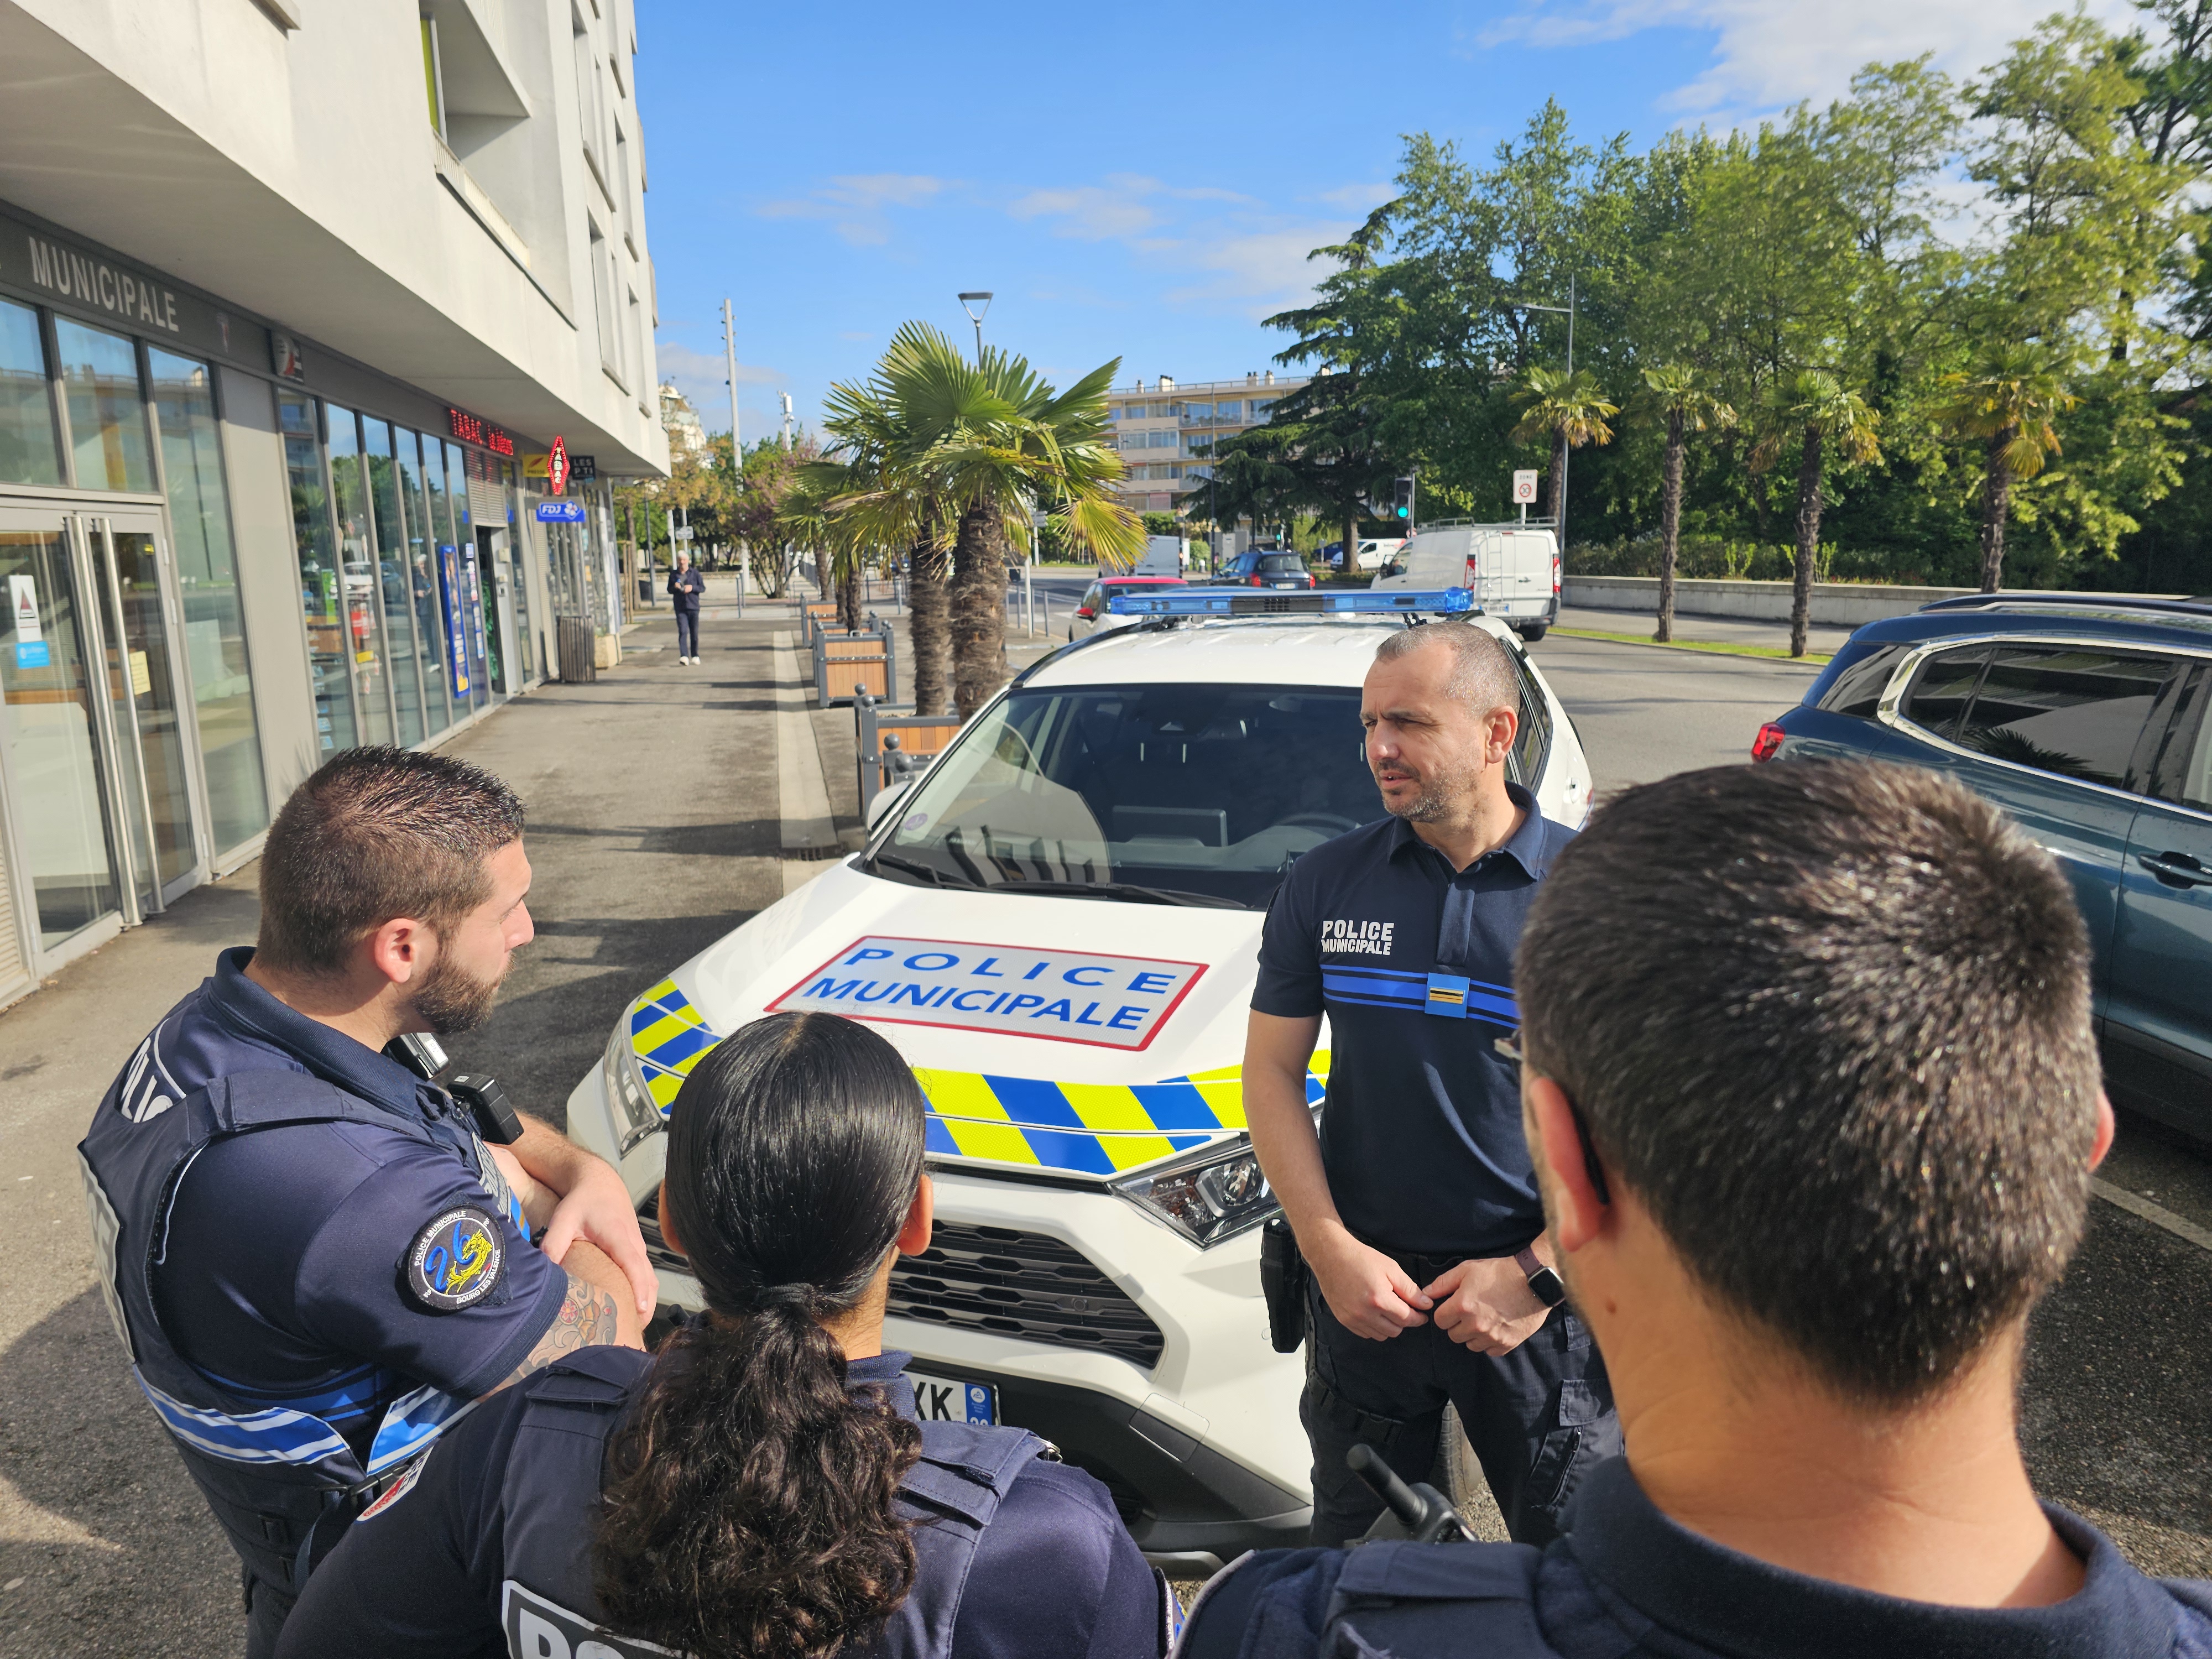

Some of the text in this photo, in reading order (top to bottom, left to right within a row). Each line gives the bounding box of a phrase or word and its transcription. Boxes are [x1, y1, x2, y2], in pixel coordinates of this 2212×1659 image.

[29, 236, 180, 332] MUNICIPALE
[542, 505, 561, 514] FDJ
[1321, 938, 1392, 956] MUNICIPALE
[1322, 919, 1395, 941] POLICE
[843, 948, 1178, 995] POLICE
[801, 977, 1151, 1030] MUNICIPALE
[415, 1210, 466, 1266] POLICE MUNICIPALE
[456, 1248, 500, 1304] BOURG LES VALENCE
